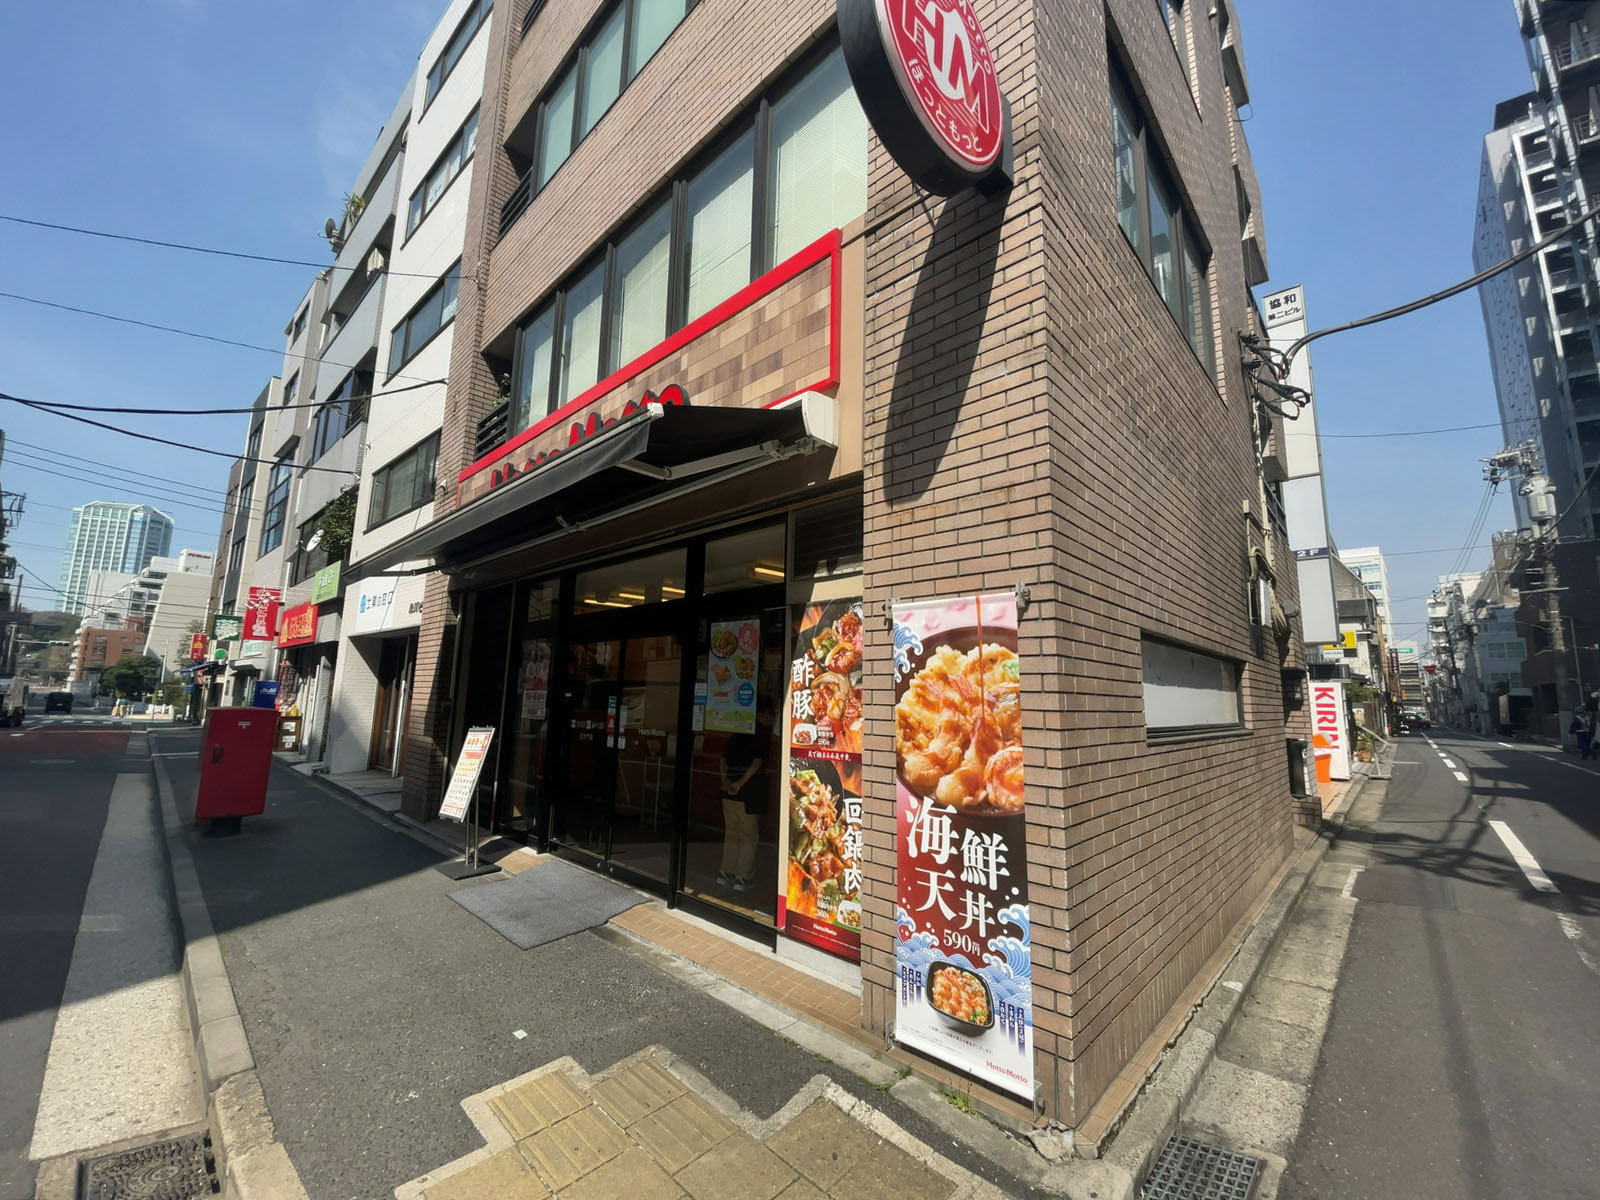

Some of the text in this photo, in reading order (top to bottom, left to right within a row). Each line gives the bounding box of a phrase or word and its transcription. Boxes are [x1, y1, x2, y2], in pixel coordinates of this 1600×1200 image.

[907, 58, 983, 153] ほっともっと
[1269, 293, 1296, 310] 協和
[792, 653, 816, 720] 酢豚
[905, 795, 1010, 891] 海鮮
[914, 866, 996, 938] 天丼
[943, 928, 981, 957] 590円
